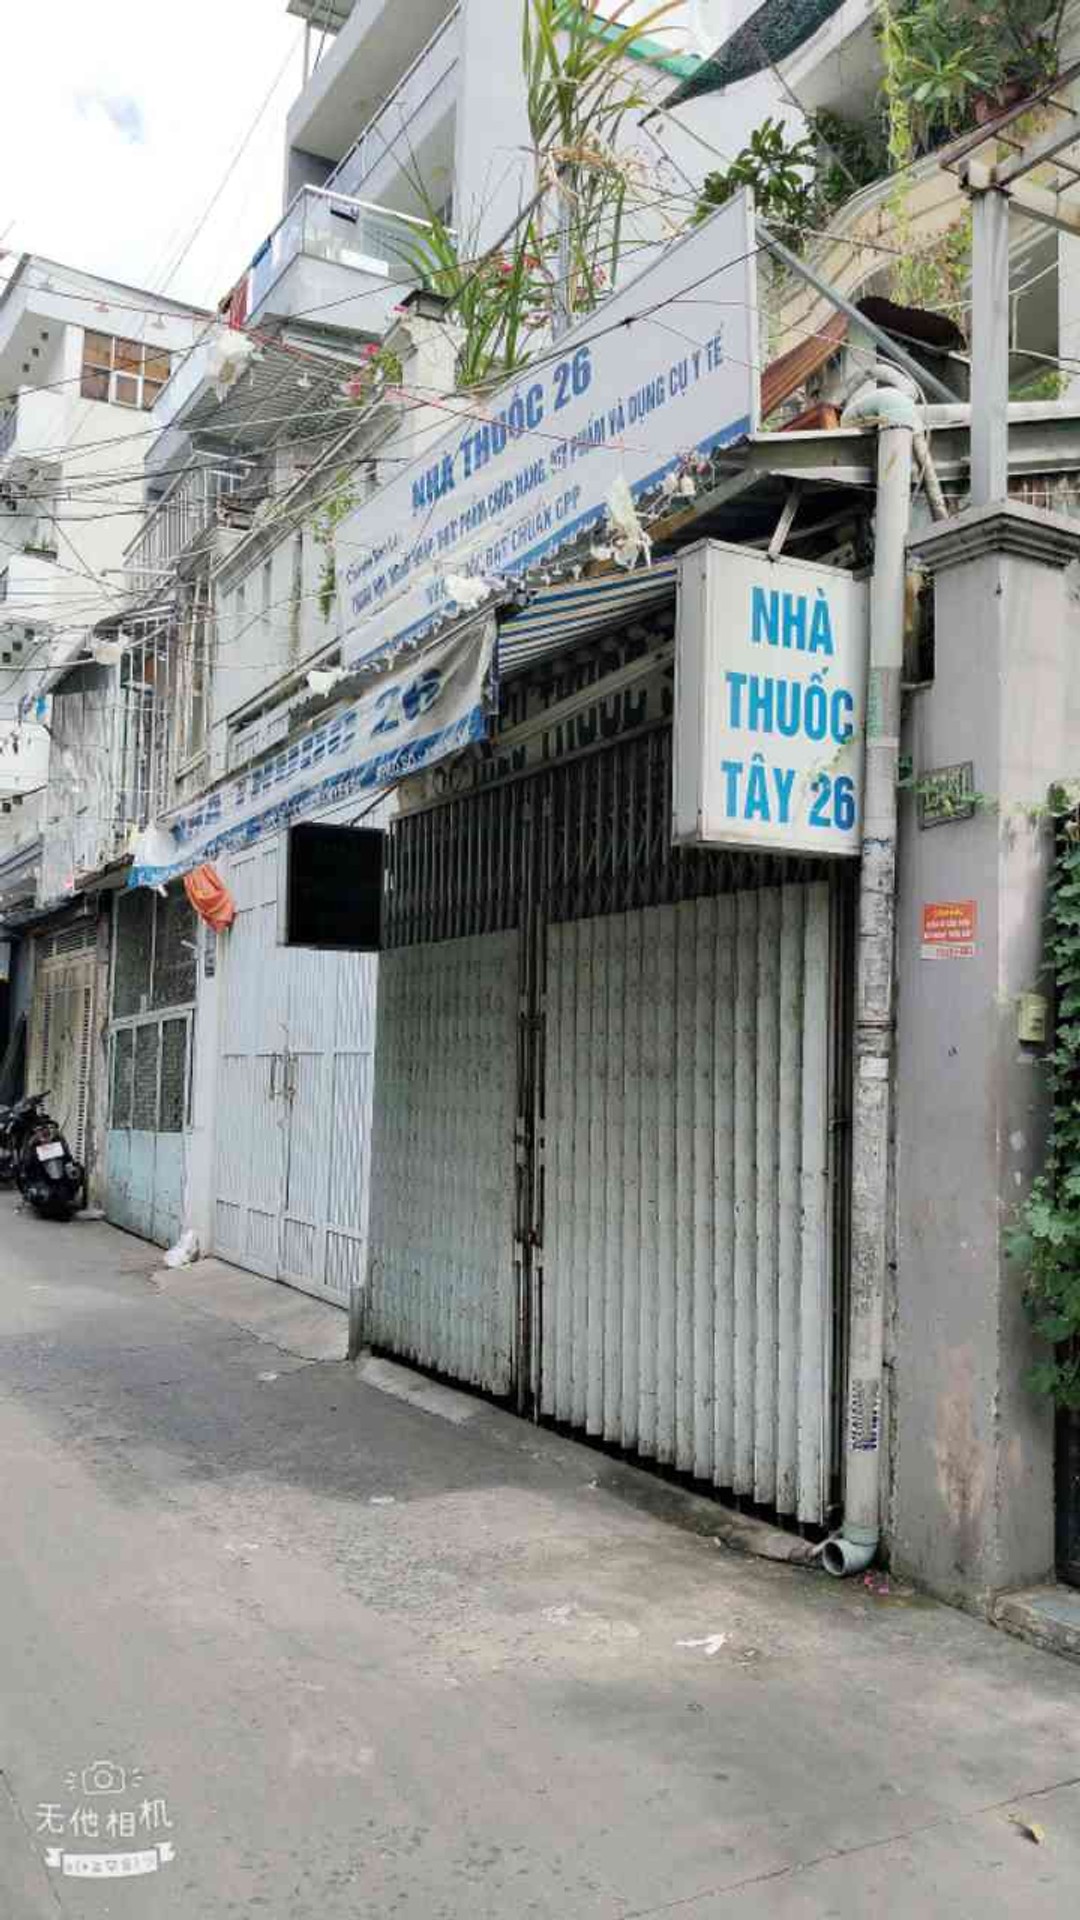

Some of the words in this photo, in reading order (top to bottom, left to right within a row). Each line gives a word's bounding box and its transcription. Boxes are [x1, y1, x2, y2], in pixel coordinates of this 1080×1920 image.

[609, 397, 625, 436] VÀ
[628, 375, 665, 424] DỤNG
[670, 358, 687, 397] CỤ
[692, 349, 701, 380] Y
[705, 322, 723, 372] TẾ
[412, 450, 455, 508] NHÀ
[460, 383, 543, 479] THUỐC
[553, 347, 592, 411] 26
[752, 586, 834, 655] NHÀ
[372, 668, 442, 735] 26
[725, 667, 854, 745] THUỐC
[721, 753, 795, 823] TÂY
[809, 775, 855, 830] 26
